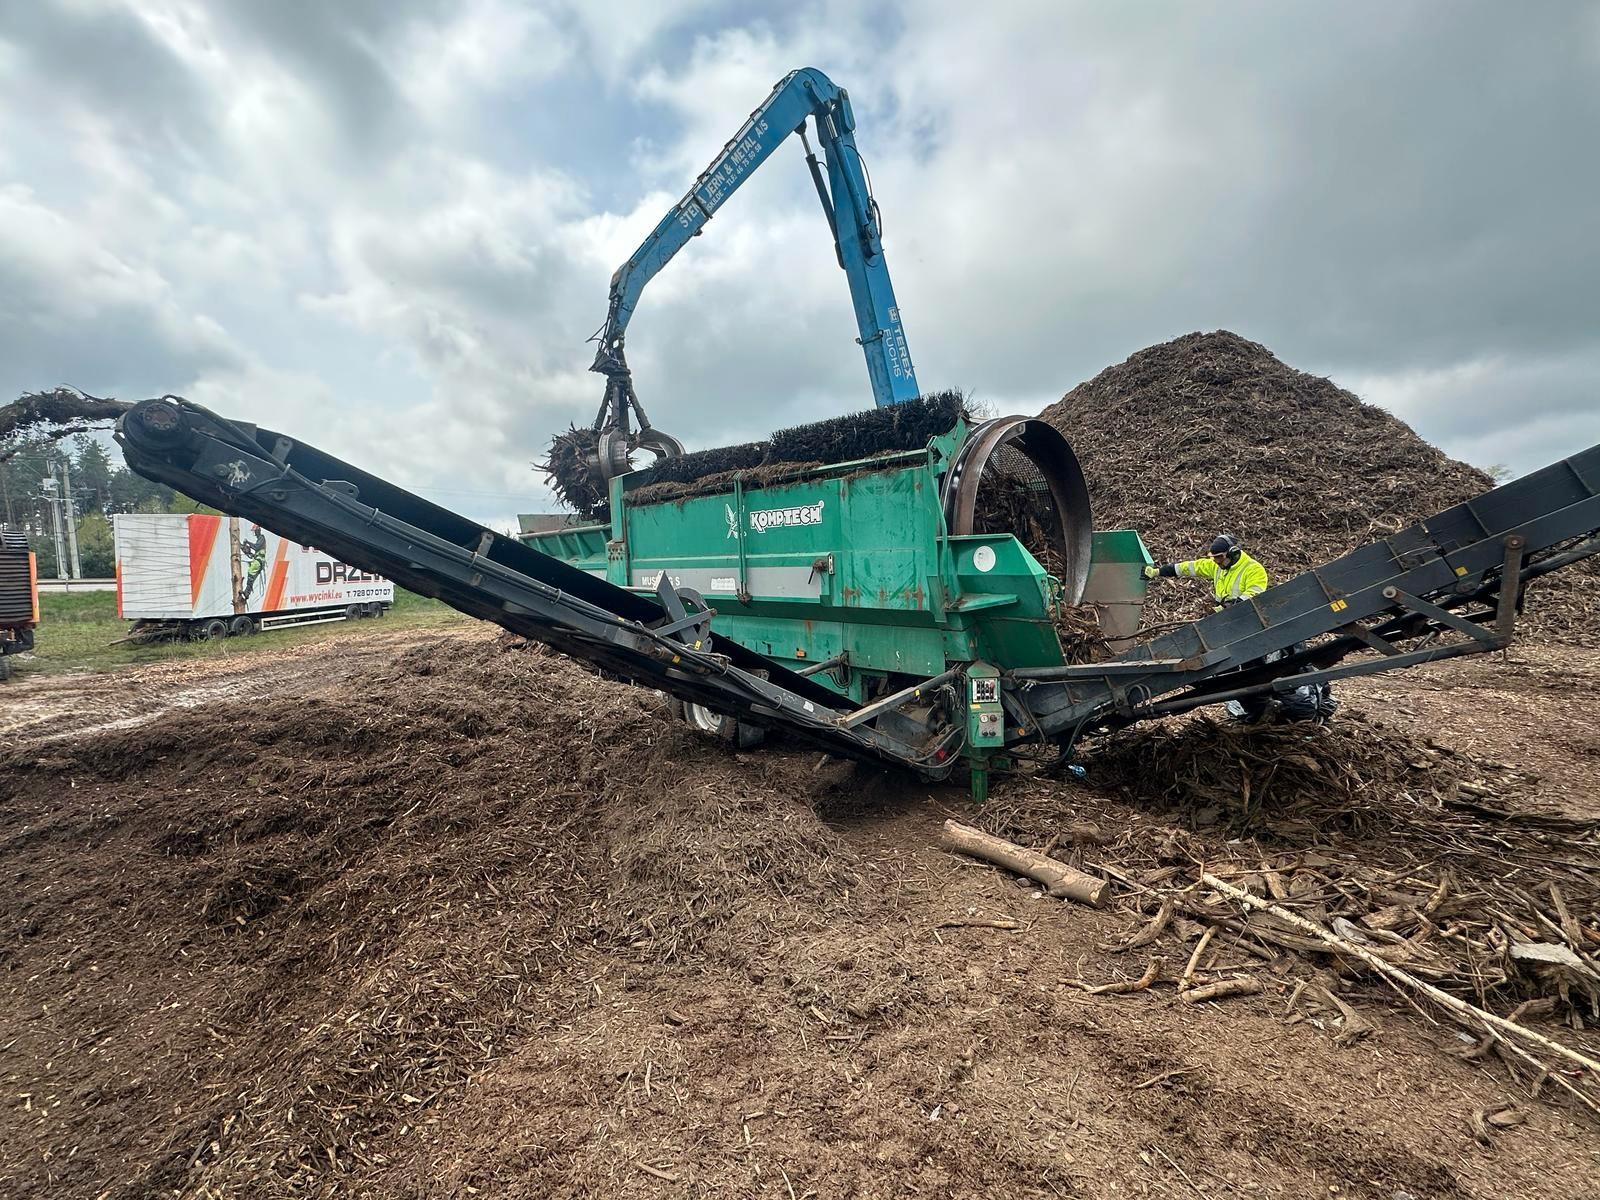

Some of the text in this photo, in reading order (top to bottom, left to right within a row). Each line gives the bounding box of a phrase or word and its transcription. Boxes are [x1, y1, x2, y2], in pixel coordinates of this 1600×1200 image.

[705, 171, 726, 198] JERN
[723, 163, 734, 175] &
[731, 136, 757, 166] METAL
[754, 119, 769, 139] A/S
[883, 329, 902, 378] FUCHS
[894, 325, 913, 381] TEREX
[749, 505, 821, 532] KOMPTECH
[290, 589, 343, 603] www.wycinki.eu
[375, 588, 383, 596] 07
[383, 588, 391, 596] 07
